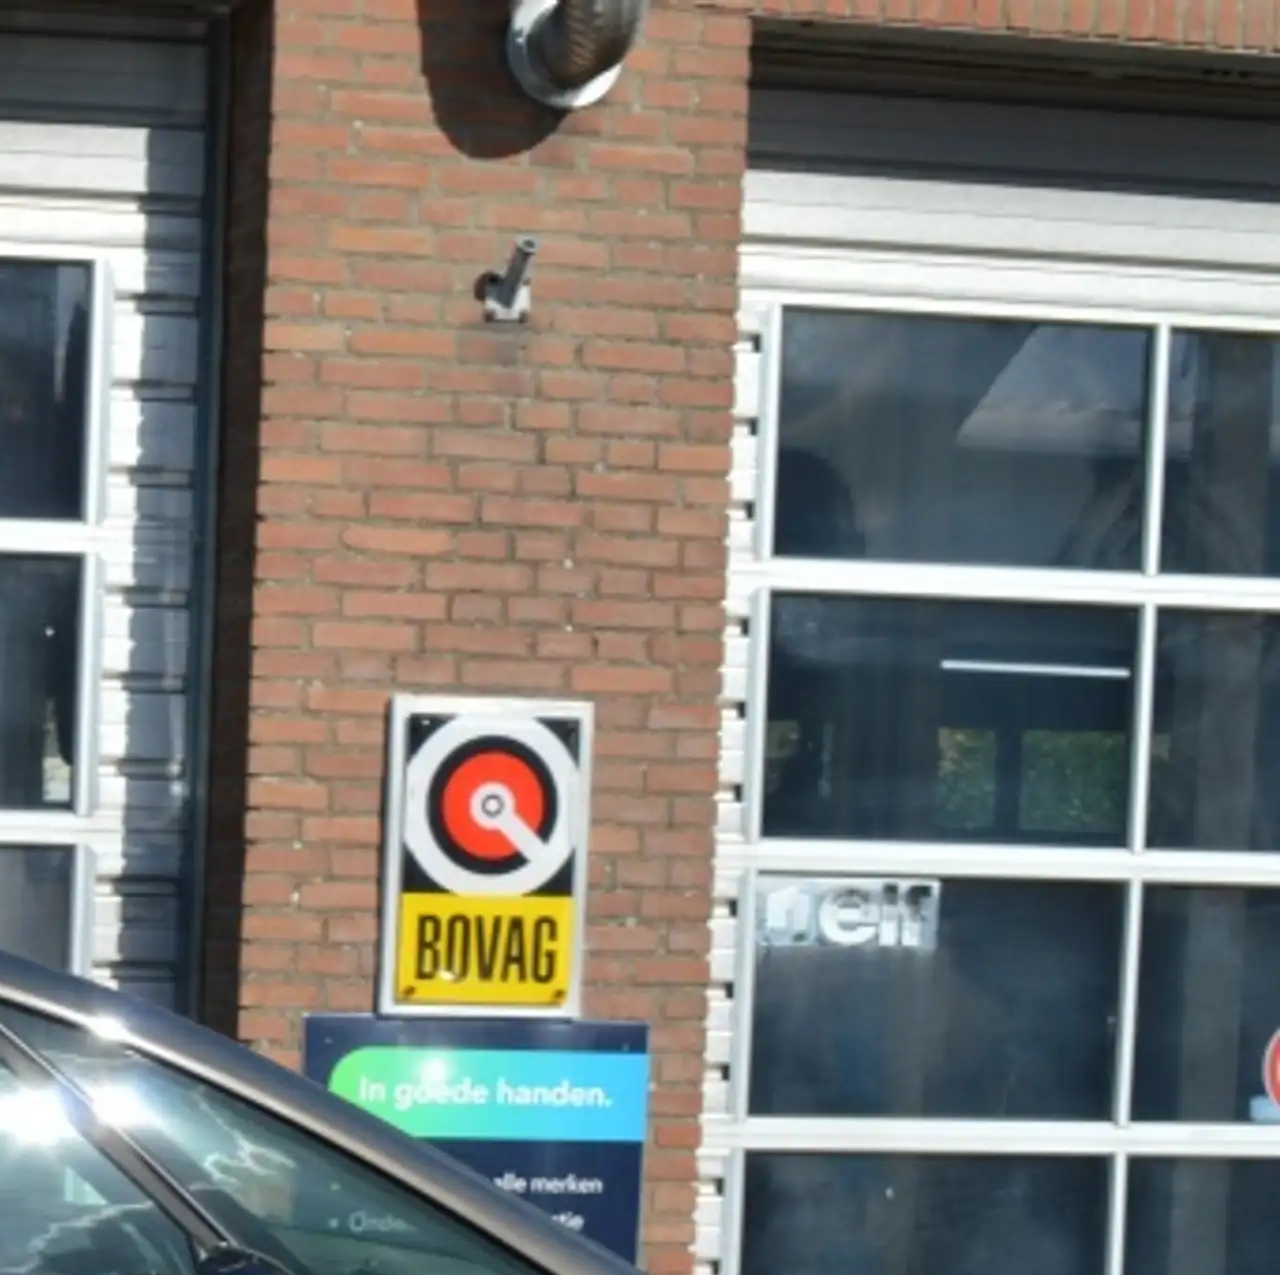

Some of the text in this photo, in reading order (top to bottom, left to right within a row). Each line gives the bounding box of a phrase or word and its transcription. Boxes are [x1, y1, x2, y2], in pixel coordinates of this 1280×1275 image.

[415, 913, 559, 985] BOVAG
[358, 1075, 614, 1111] In goede handen.
[530, 1172, 603, 1194] merken
